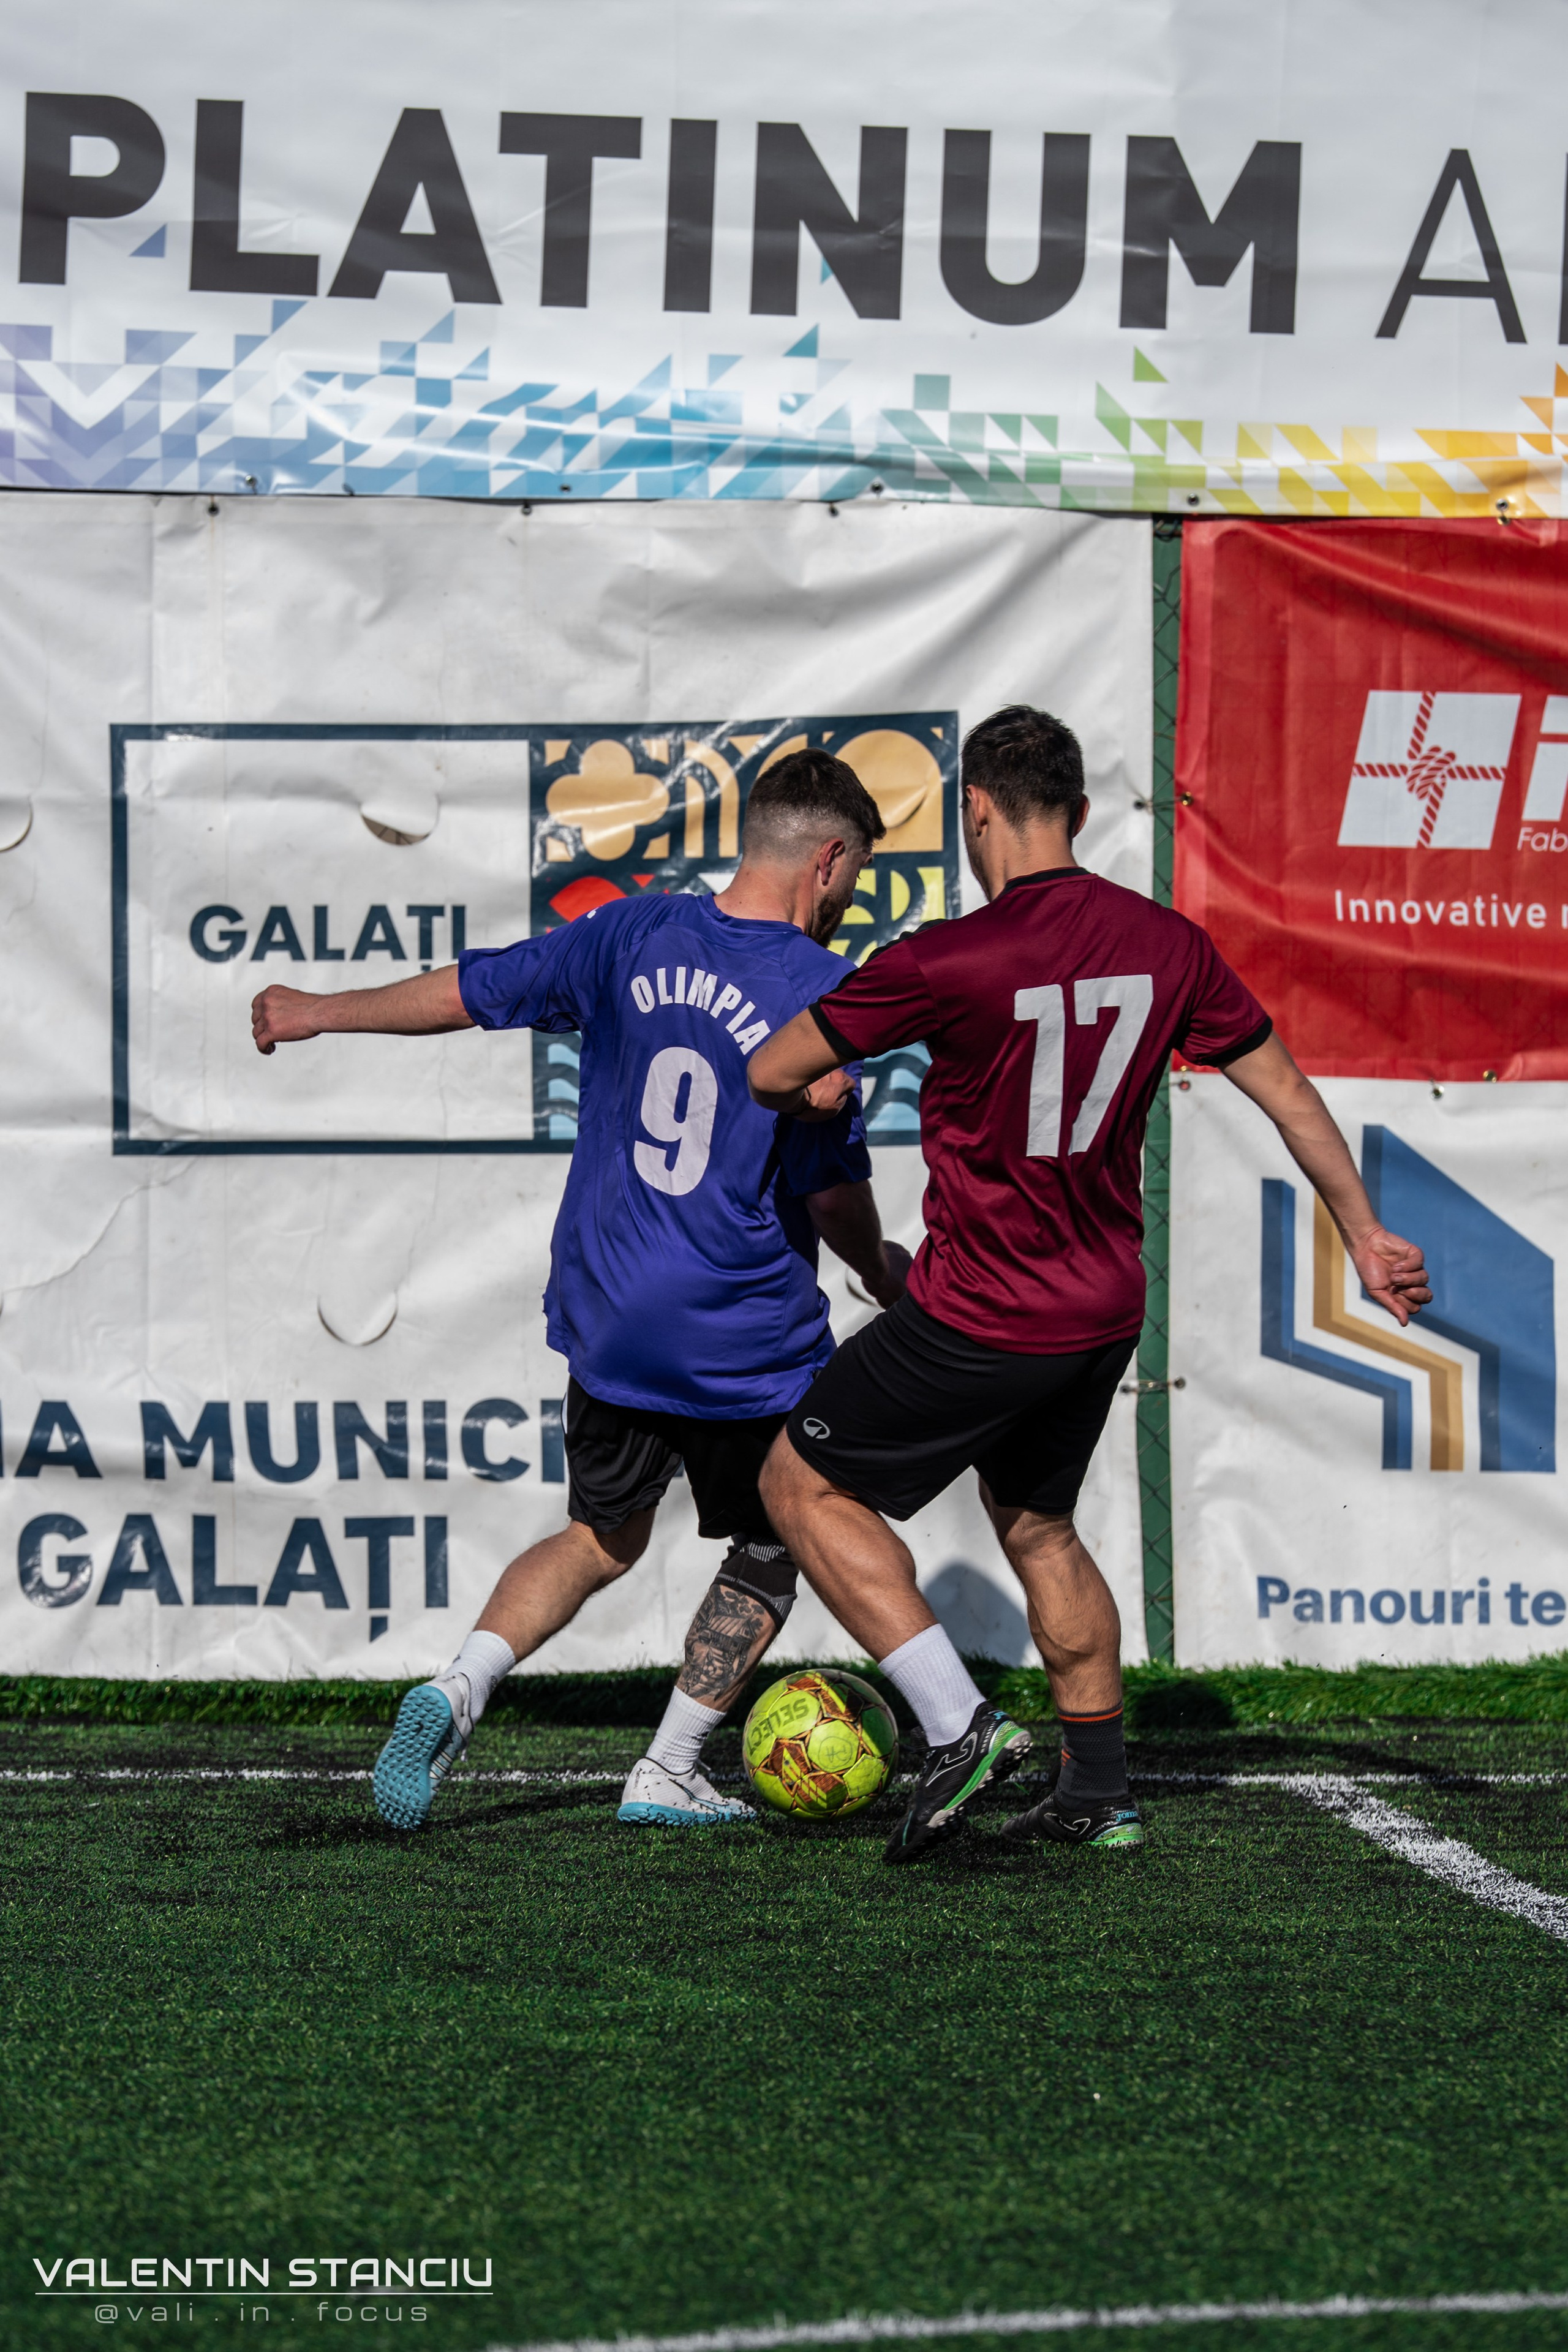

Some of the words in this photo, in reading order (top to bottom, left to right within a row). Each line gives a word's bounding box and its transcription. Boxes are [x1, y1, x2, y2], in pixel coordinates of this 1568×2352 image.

[19, 91, 1303, 334] PLATINUM
[1374, 148, 1568, 345] A
[1335, 889, 1547, 929] Innovative
[631, 967, 771, 1055] OLIMPIA
[1014, 974, 1154, 1158] 17
[633, 1047, 718, 1196] 9
[0, 1398, 103, 1479] A
[17, 1512, 449, 1643] GALAȚI
[1256, 1575, 1491, 1625] Panouri
[747, 1698, 810, 1756] SELECT
